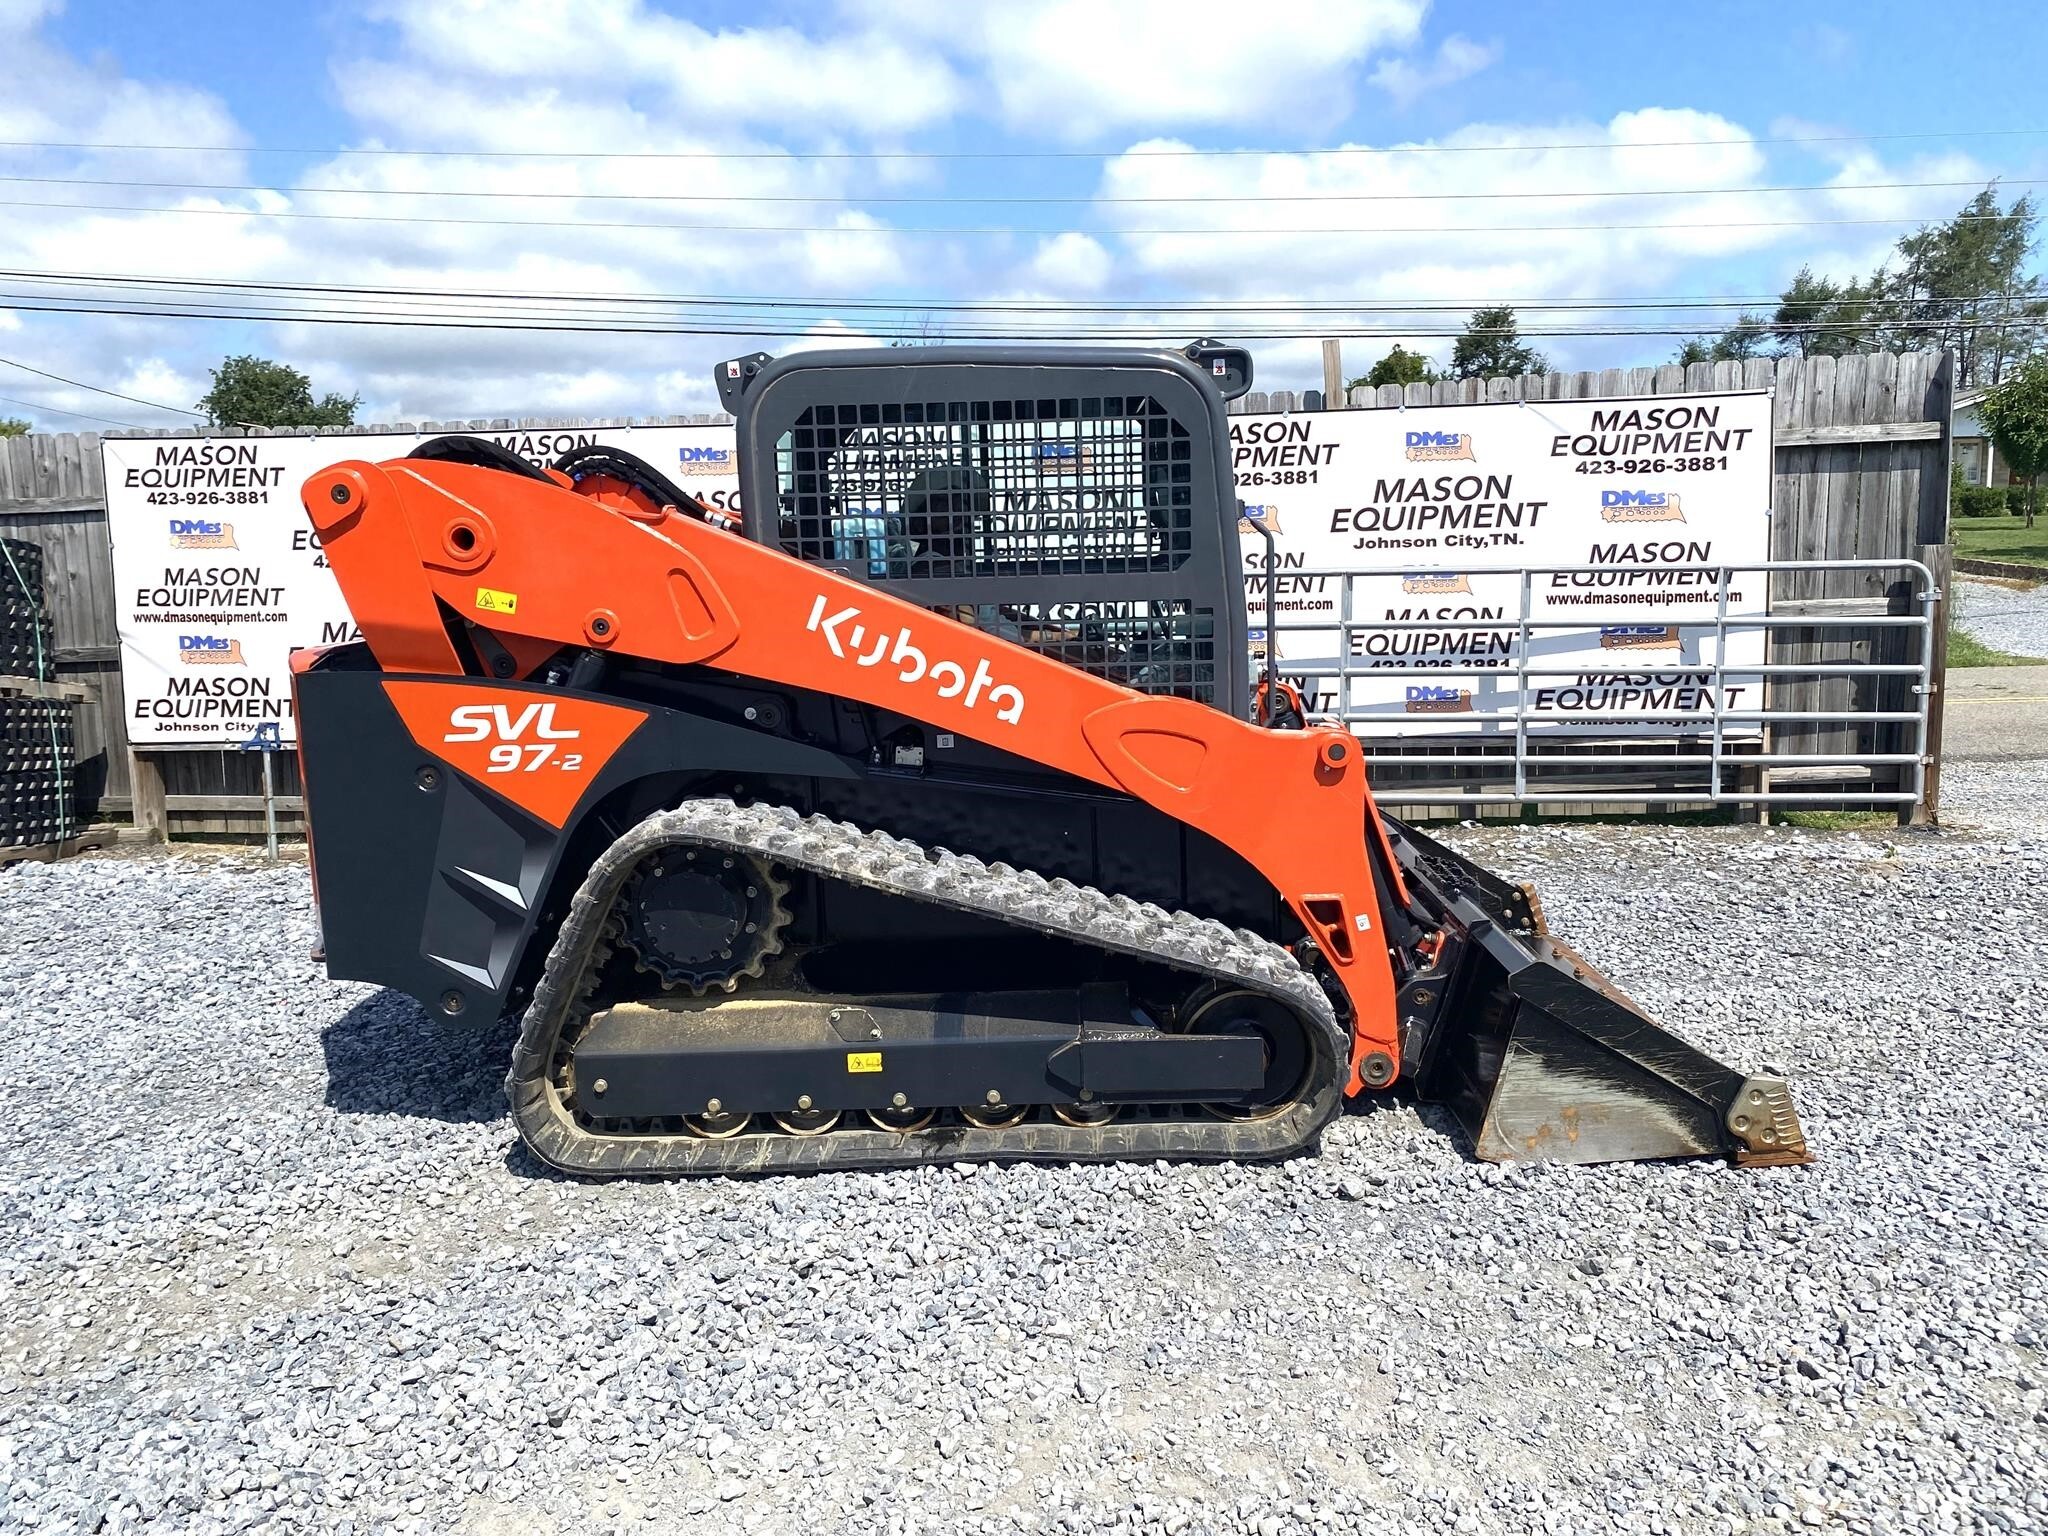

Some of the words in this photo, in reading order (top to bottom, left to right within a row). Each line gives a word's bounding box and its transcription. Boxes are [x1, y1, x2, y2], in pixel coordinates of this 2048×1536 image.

[1591, 406, 1720, 432] MASON
[1229, 421, 1311, 445] ASON
[1551, 429, 1752, 457] EQUIPMENT
[156, 445, 258, 466] MASON
[1231, 444, 1340, 468] PMENT
[1575, 456, 1727, 474] 423-926-3881
[125, 467, 285, 488] EQUIPMENT
[147, 491, 268, 505] 423-926-3881
[1373, 474, 1513, 503] MASON
[1330, 502, 1548, 533] EQUIPMENT
[1353, 537, 1437, 550] Johnson
[1444, 533, 1525, 549] City,TN.
[1589, 541, 1711, 564] MASON
[164, 567, 260, 586] MASON
[136, 588, 285, 607] EQUIPMENT
[133, 611, 288, 625] www.dmasonequipment.com
[805, 594, 1025, 726] Kubota
[167, 677, 270, 697] MASON
[135, 698, 295, 718] EQUIPMENT
[1535, 688, 1745, 710] EQUIPMENT
[154, 722, 219, 732] Johnson
[443, 703, 580, 742] SVL
[487, 744, 583, 773] 97-2
